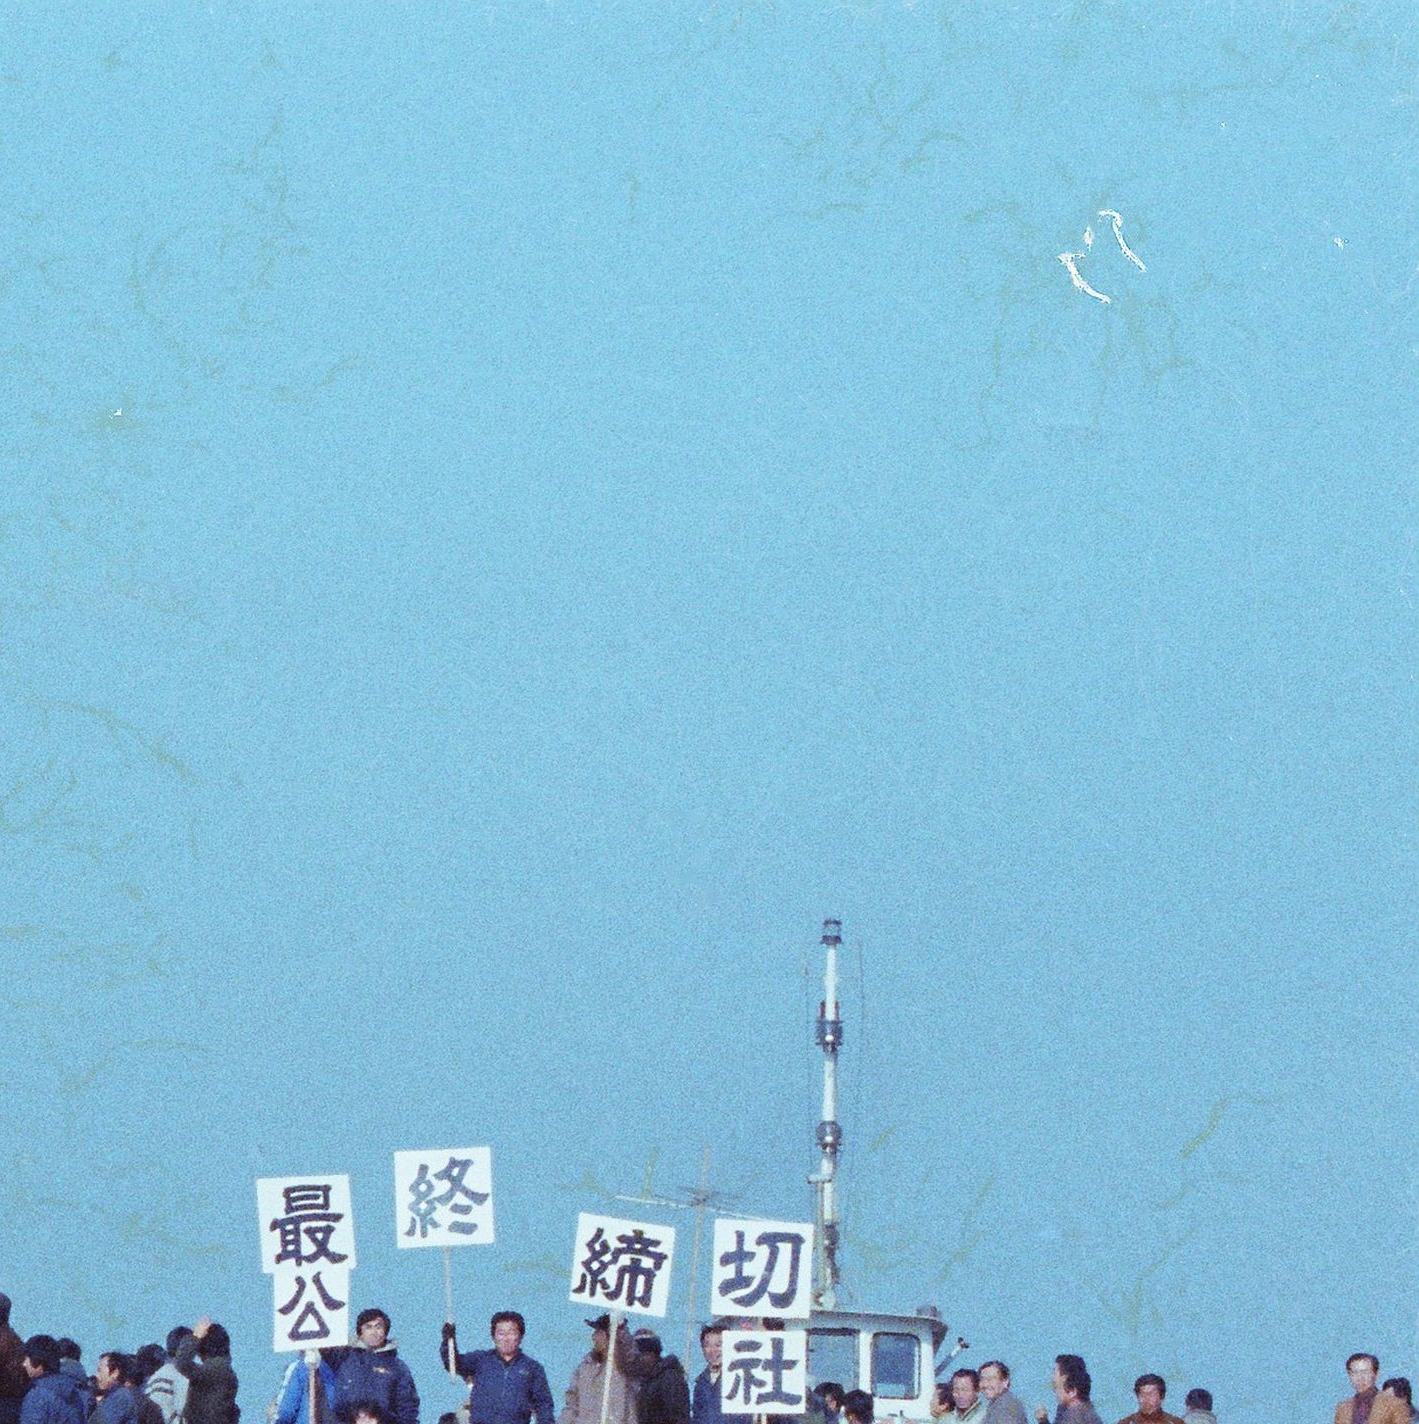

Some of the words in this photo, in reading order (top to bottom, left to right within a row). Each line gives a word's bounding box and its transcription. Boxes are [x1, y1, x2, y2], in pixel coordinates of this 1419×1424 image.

[269, 1184, 348, 1266] 最
[404, 1156, 490, 1238] 終
[278, 1271, 346, 1342] 公
[572, 1227, 668, 1308] 締
[718, 1230, 805, 1309] 切
[725, 1337, 802, 1406] 社
